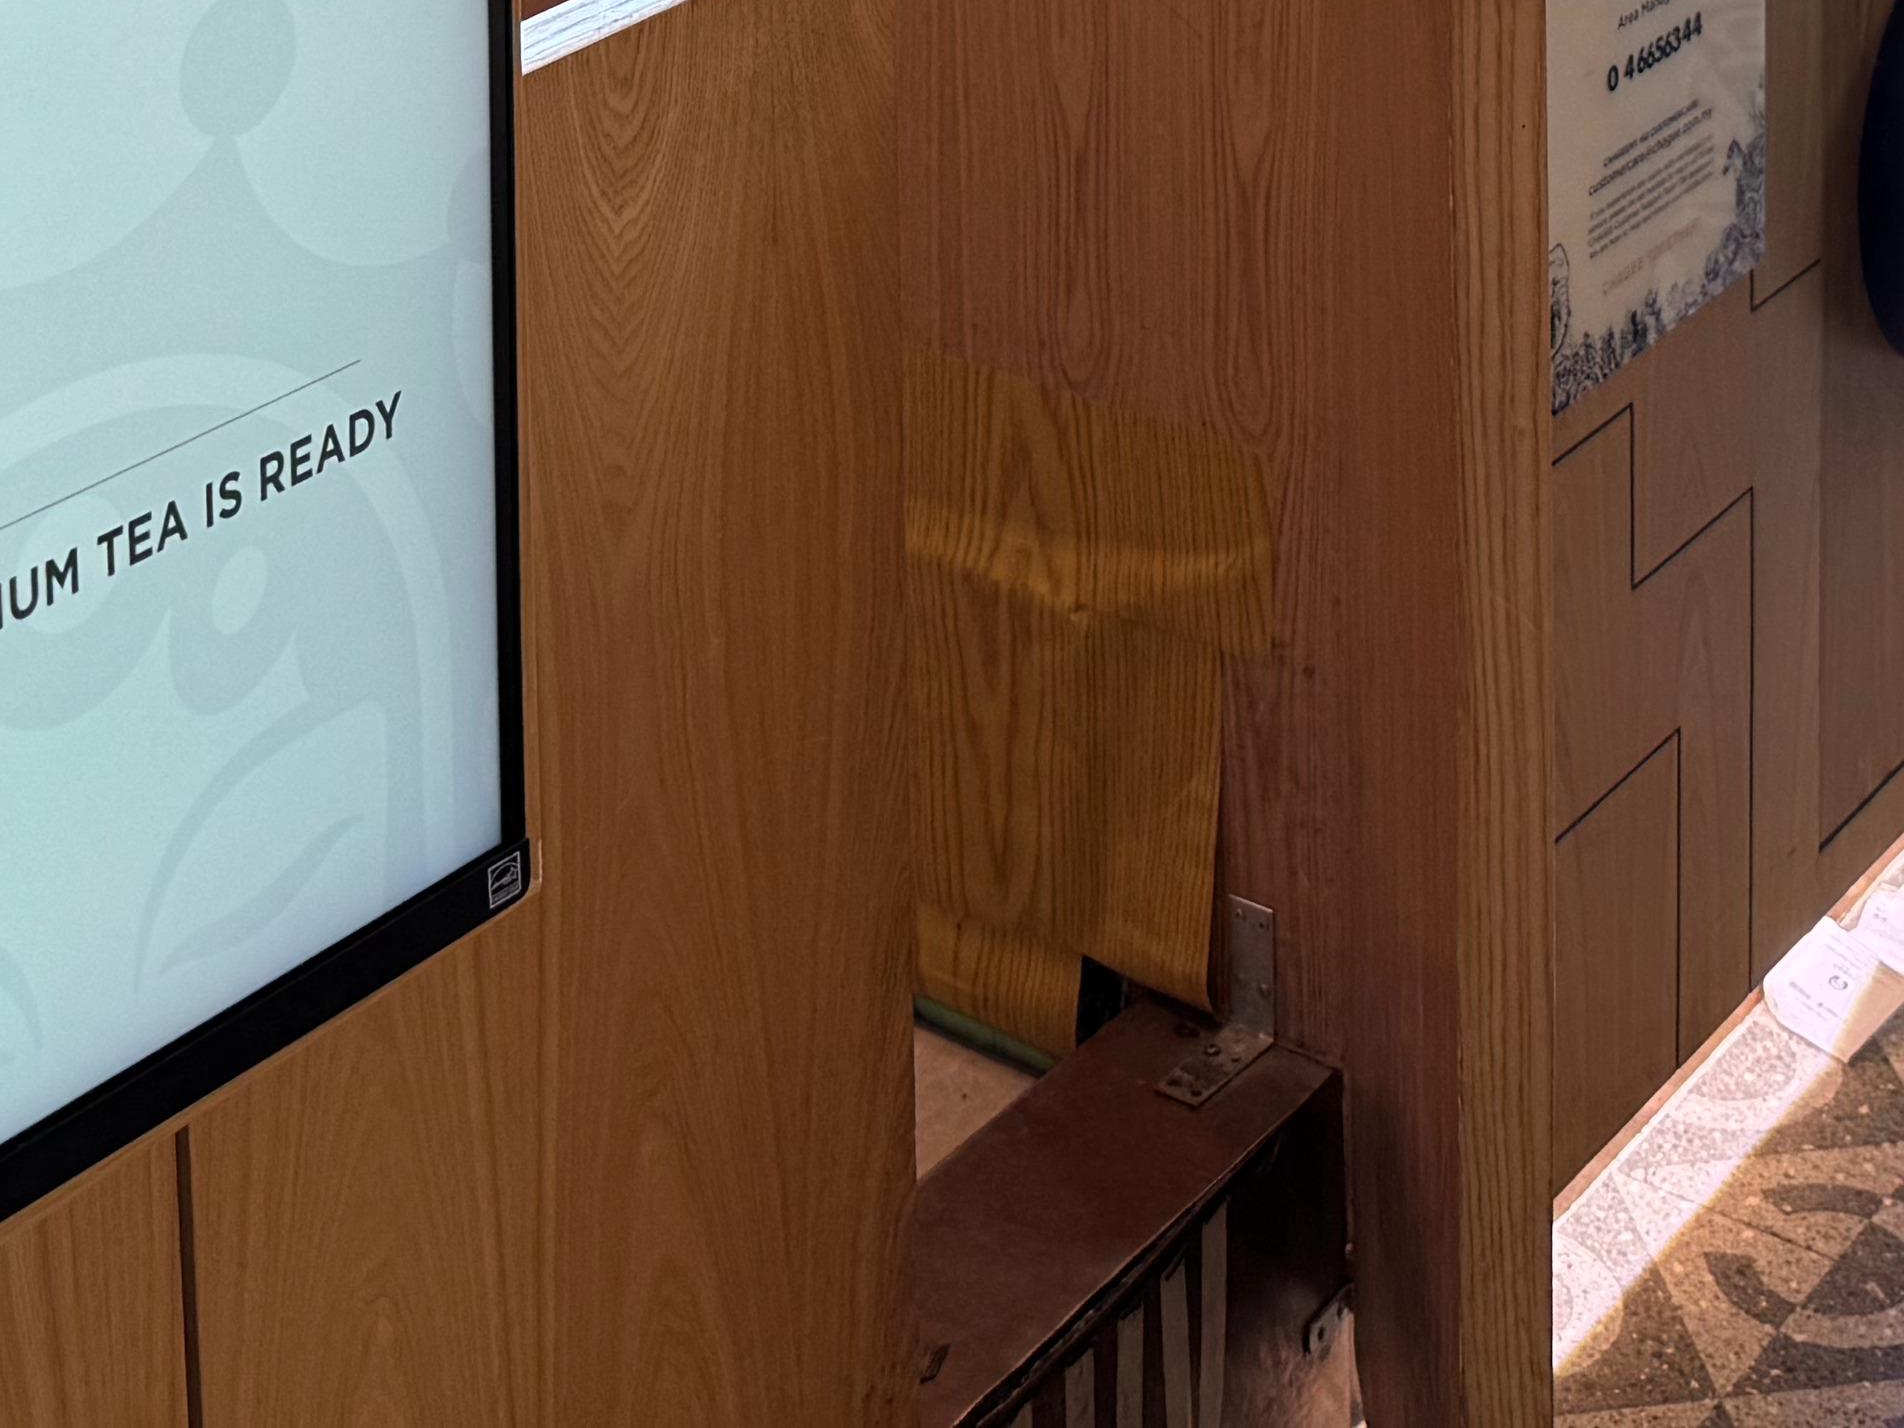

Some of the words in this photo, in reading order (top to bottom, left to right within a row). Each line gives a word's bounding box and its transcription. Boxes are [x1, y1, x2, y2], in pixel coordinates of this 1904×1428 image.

[1616, 8, 1639, 31] Area
[96, 500, 188, 579] TEA
[203, 472, 244, 529] IS
[258, 392, 403, 501] READY
